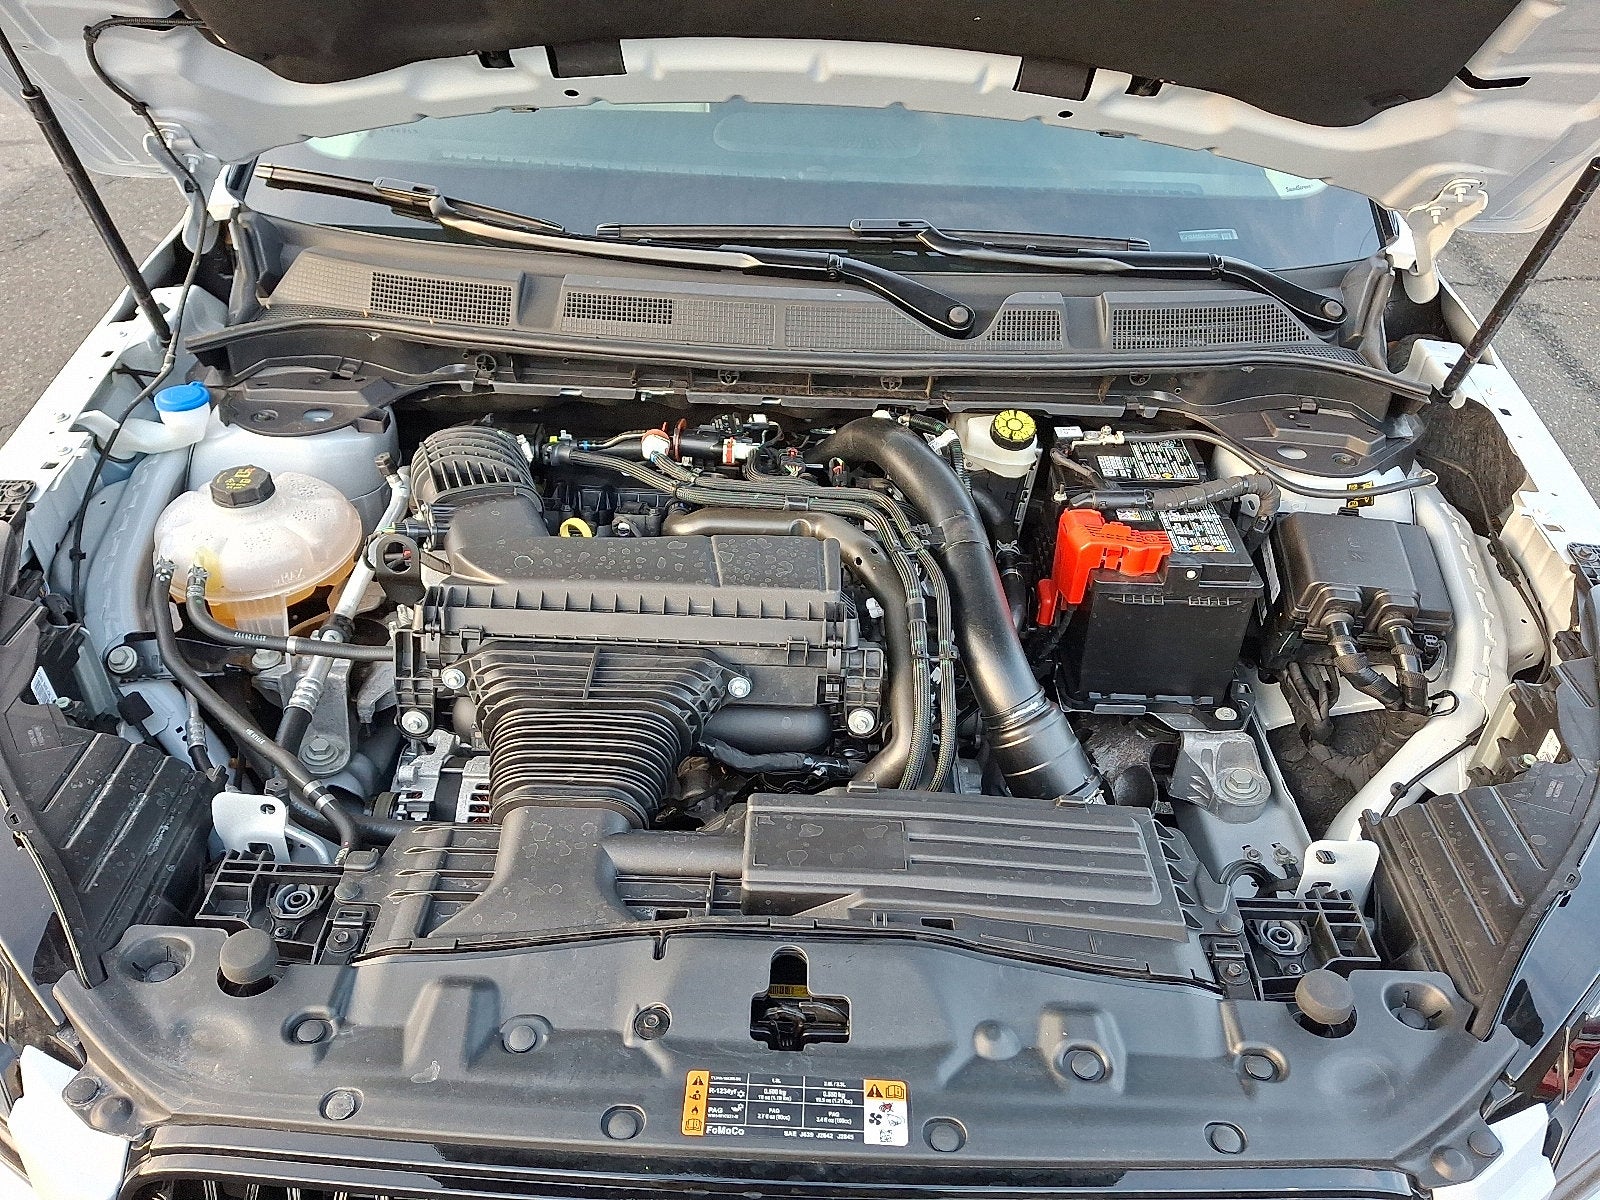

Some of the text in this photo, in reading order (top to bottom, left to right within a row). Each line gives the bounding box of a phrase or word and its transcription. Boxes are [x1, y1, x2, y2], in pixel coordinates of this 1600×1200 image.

[709, 1087, 737, 1096] R-1234yf
[708, 1106, 723, 1114] PAG
[705, 1125, 745, 1136] FoMoCo
